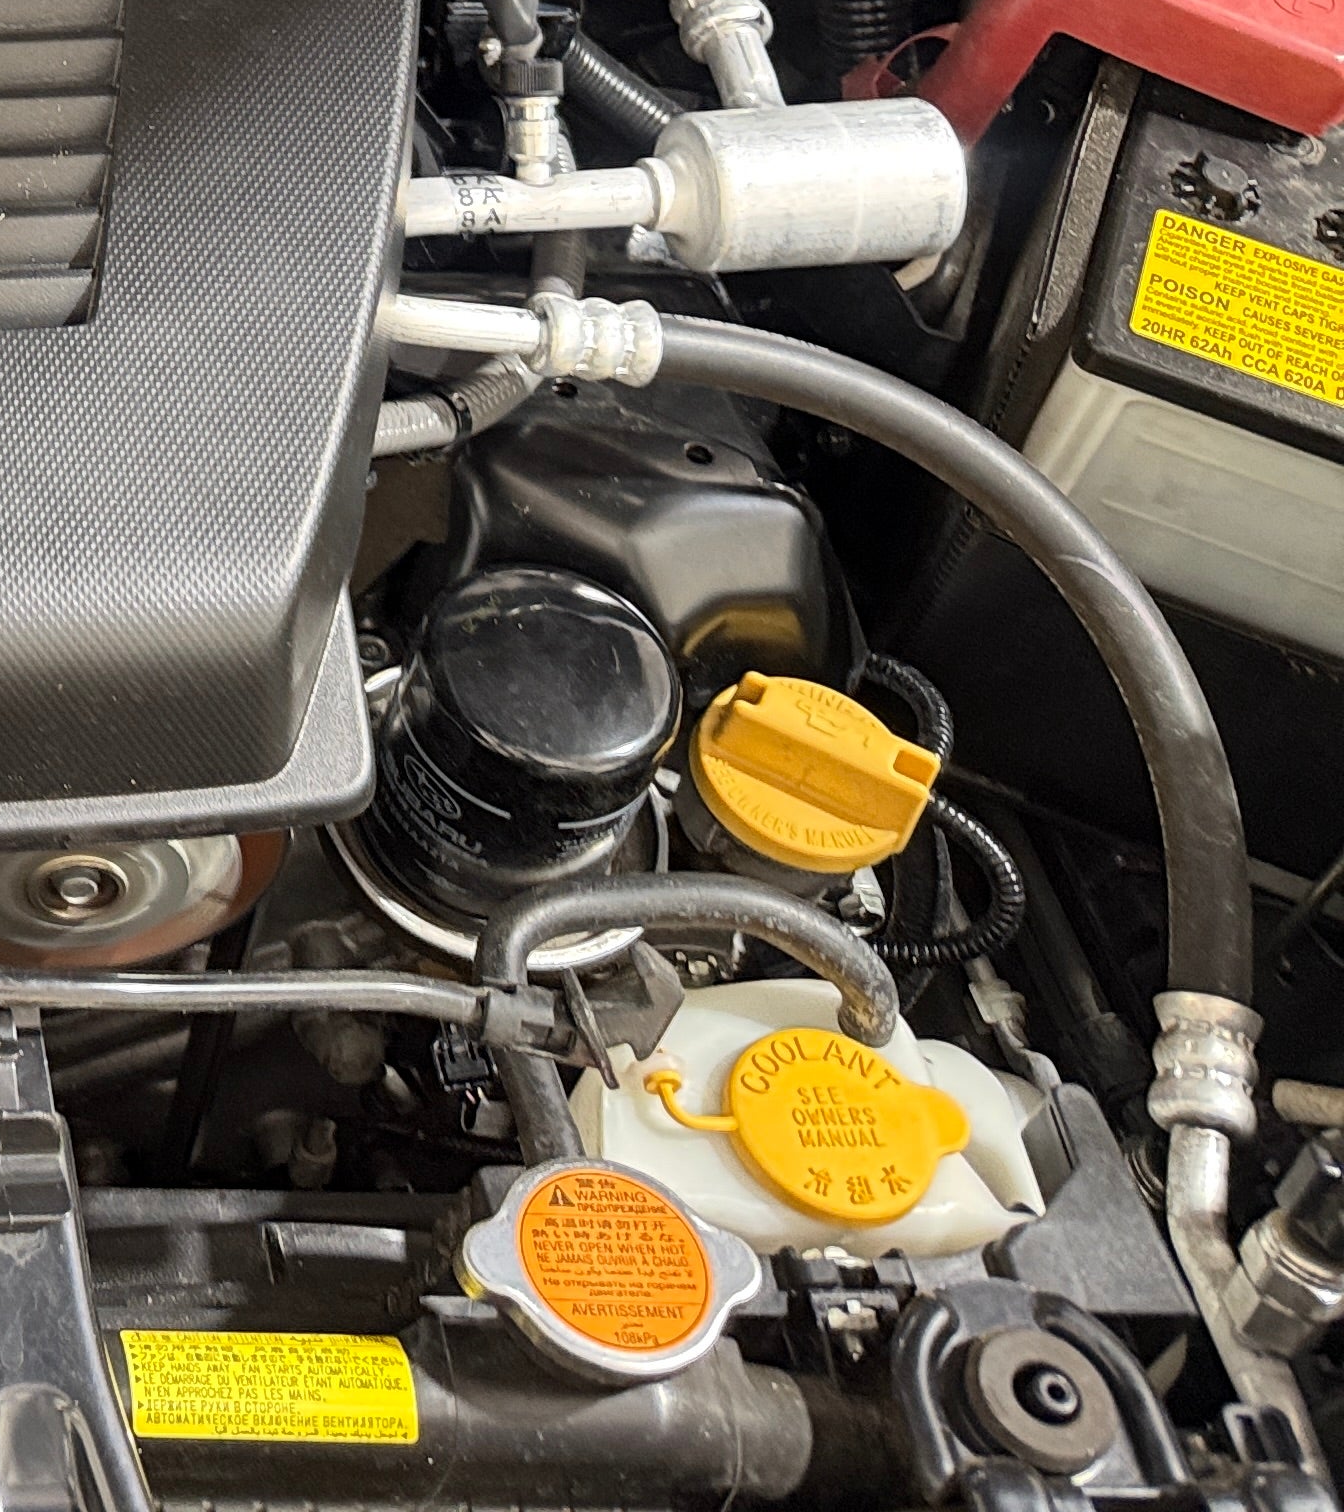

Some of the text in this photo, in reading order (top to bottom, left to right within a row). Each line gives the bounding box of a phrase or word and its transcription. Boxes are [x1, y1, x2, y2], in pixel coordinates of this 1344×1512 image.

[459, 187, 501, 206] 8 A
[462, 208, 501, 227] 8 A
[1162, 216, 1246, 253] DANGER
[1254, 248, 1319, 277] EXPLOSIVE
[1149, 273, 1230, 311] POISON
[1242, 306, 1291, 332] CAUSES
[1214, 281, 1246, 299] KEEP
[1248, 293, 1279, 311] VENT
[1282, 304, 1315, 323] CAPS
[1140, 317, 1186, 344] 20HR
[1189, 334, 1233, 360] 62Ah
[1241, 353, 1281, 378] CCA
[1283, 368, 1328, 394] 620A
[1204, 325, 1236, 344] KEEP
[1238, 338, 1263, 354] OUT
[1267, 347, 1283, 361] OF
[1286, 354, 1329, 377] REACH
[740, 1036, 901, 1095] COOLANT
[797, 1087, 843, 1105] SEE
[792, 1107, 877, 1126] OWNERS
[798, 1128, 886, 1148] MANUAL
[574, 1190, 647, 1203] WARNING
[534, 1240, 685, 1256] NEVER OPEN WHEN HOT
[537, 1252, 550, 1263] NE
[556, 1253, 593, 1265] JAMAIS
[597, 1254, 637, 1266] OUVRIR
[653, 1256, 689, 1267] CHAUD
[572, 1302, 684, 1319] AVERTISSEMENT
[614, 1330, 658, 1346] 108kPa
[141, 1362, 165, 1372] KEEP
[171, 1362, 201, 1373] HANDS
[242, 1364, 260, 1373] FAN
[265, 1365, 302, 1375] STARTS
[143, 1373, 157, 1384] LE
[217, 1374, 230, 1386] DU
[233, 1373, 299, 1387] VENTILATEUR
[144, 1386, 327, 1403] N'EN APPROCHEZ PAS LES MAINS.
[146, 1400, 196, 1411] ДЕРЖИТЕ
[244, 1402, 300, 1415] СТОРОНЕ.
[146, 1413, 249, 1425] АВТОМАТИЧЕСКОЕ
[253, 1415, 318, 1426] ВКЛЮЧЕНИЕ
